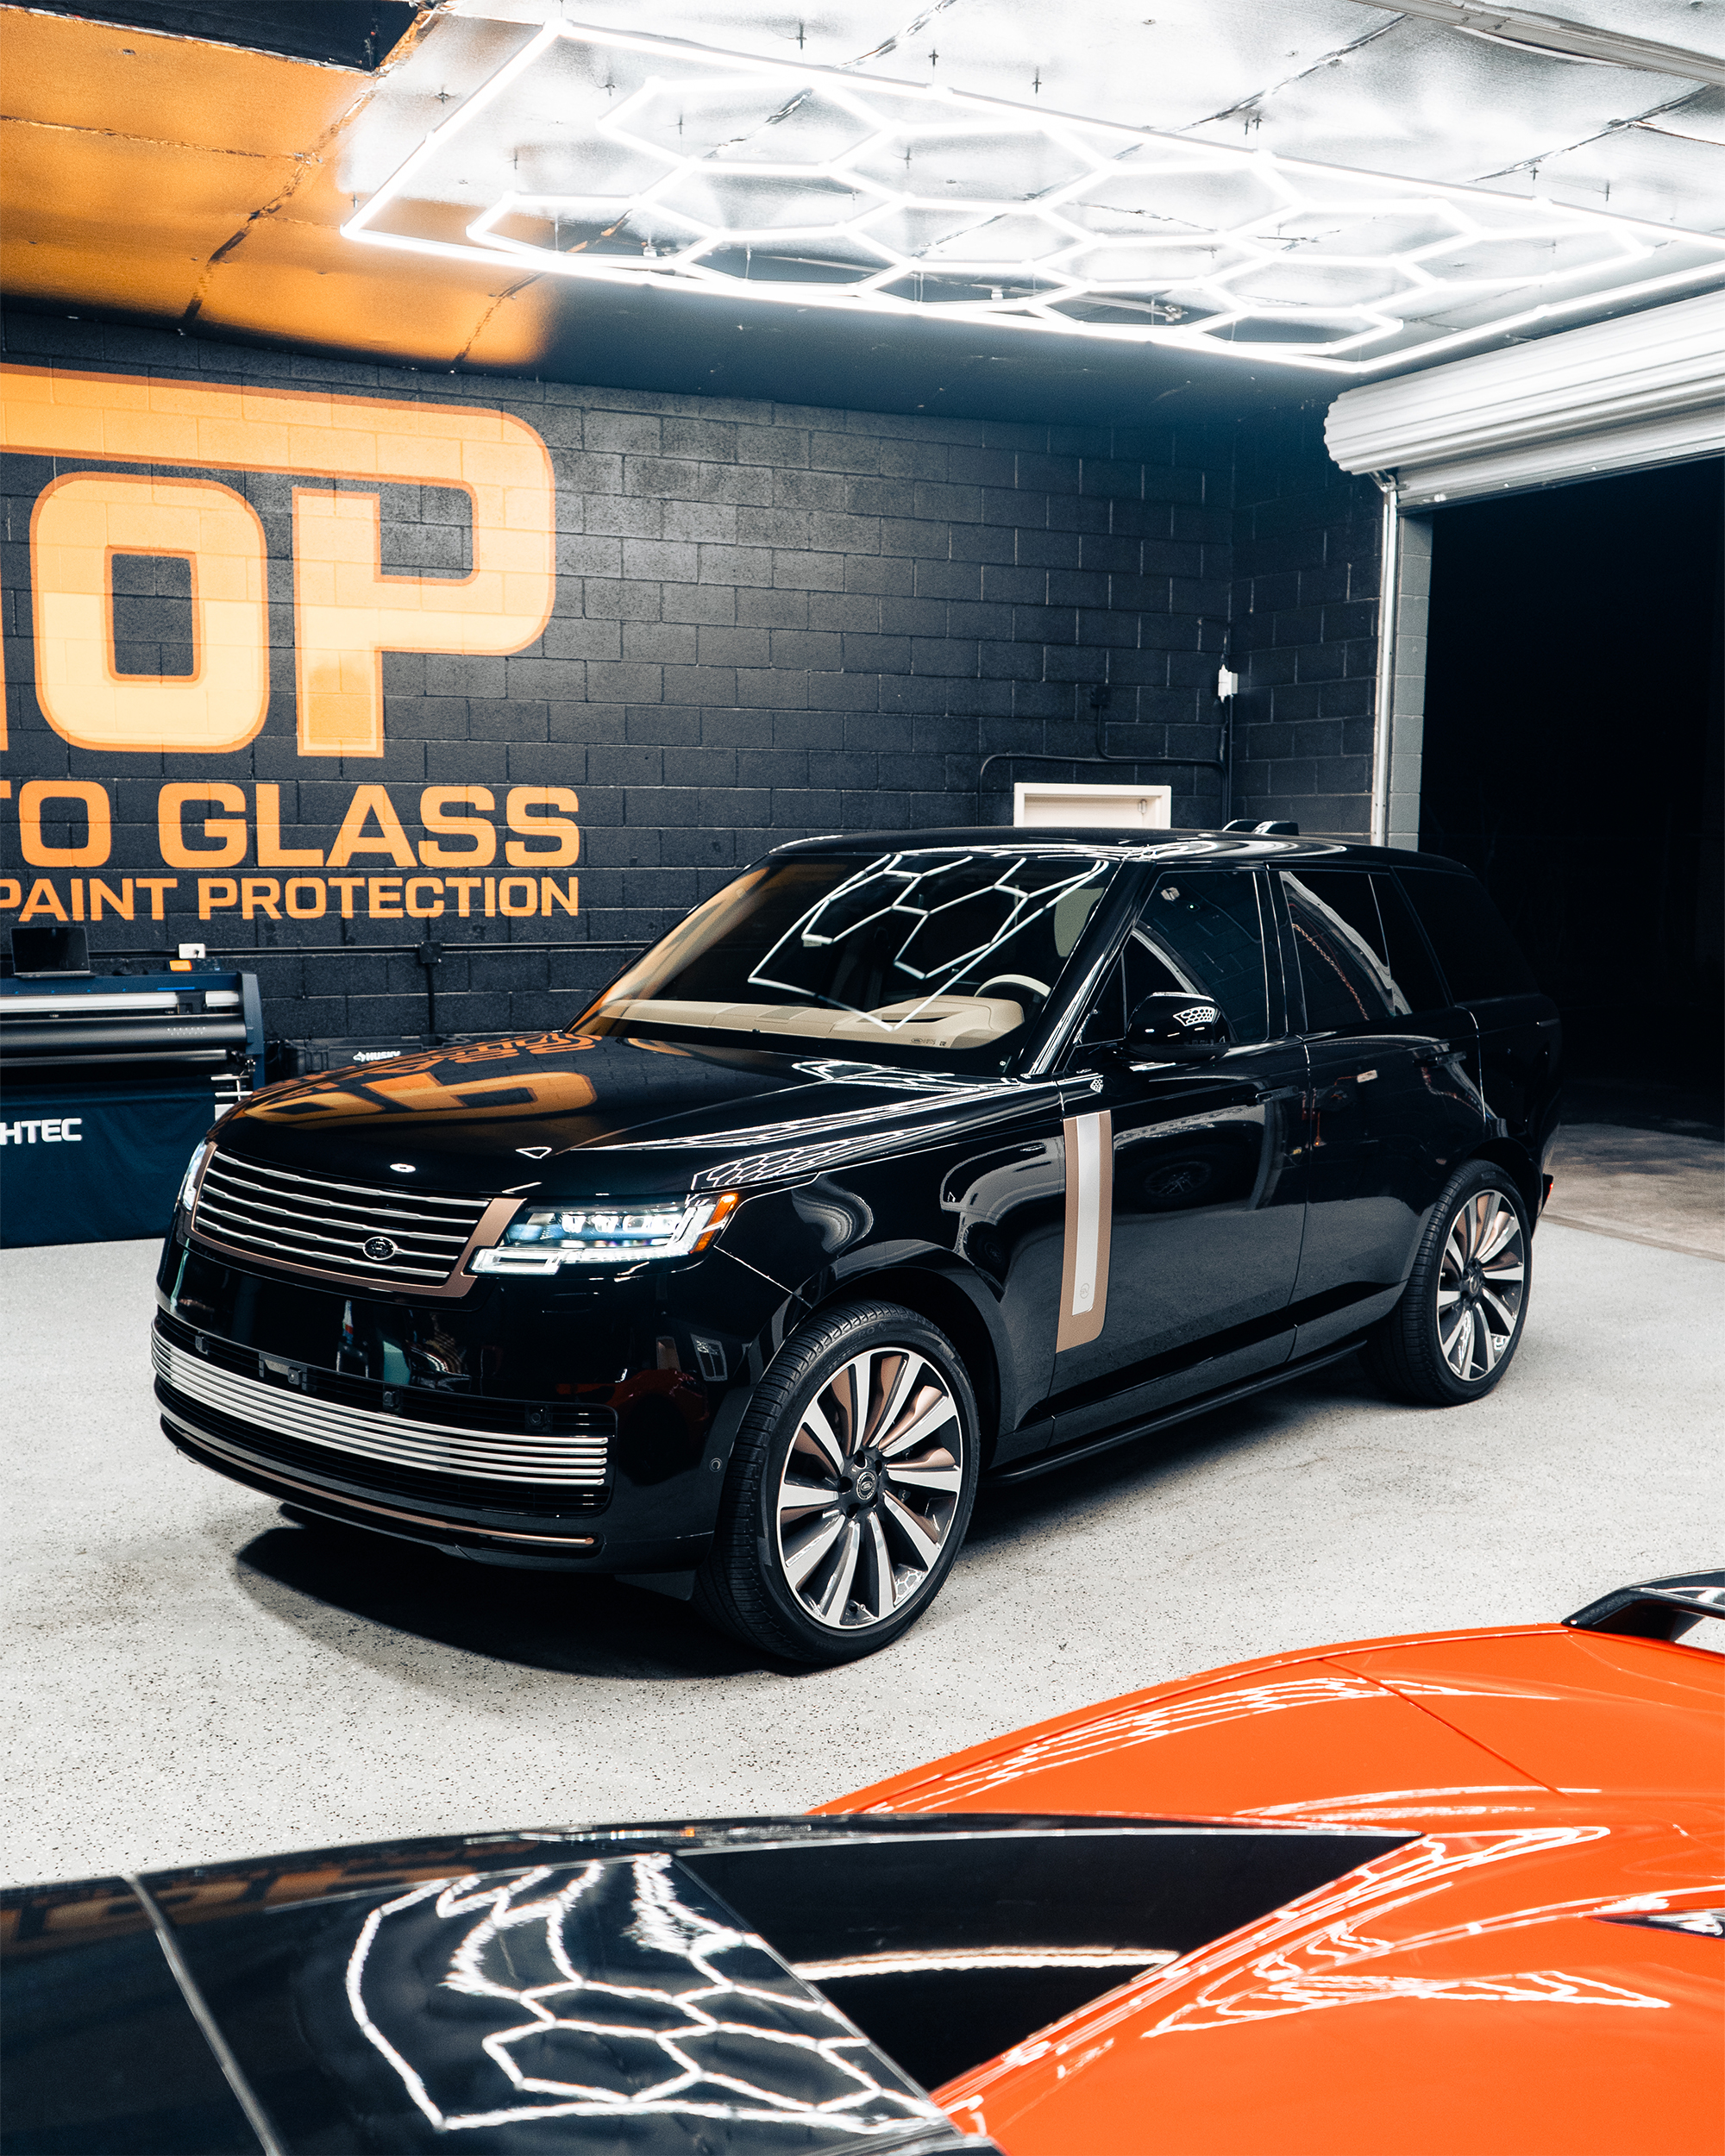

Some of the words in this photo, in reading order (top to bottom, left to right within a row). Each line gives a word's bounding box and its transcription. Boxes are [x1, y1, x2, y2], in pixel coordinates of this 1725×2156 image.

[0, 780, 111, 868] O
[158, 782, 580, 868] GLASS
[198, 876, 579, 920] PROTECTION
